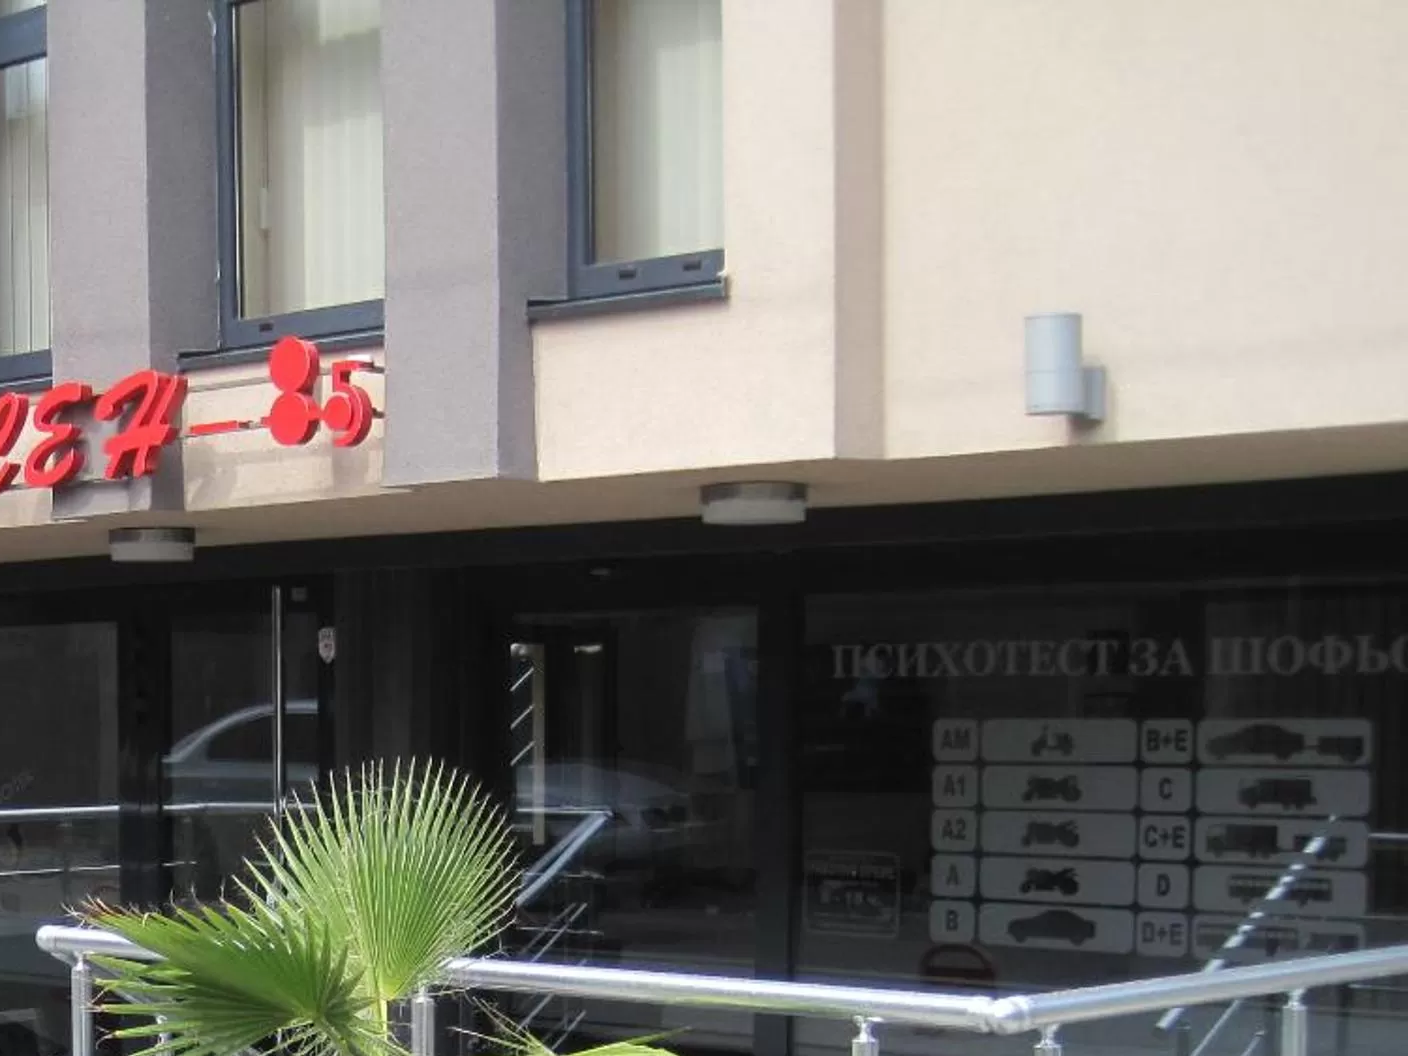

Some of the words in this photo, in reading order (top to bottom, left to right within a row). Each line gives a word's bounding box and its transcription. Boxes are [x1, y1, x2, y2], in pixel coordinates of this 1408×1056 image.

[831, 638, 1128, 679] ПСИХОТЕСТ
[1129, 636, 1192, 677] ЗА
[1146, 729, 1189, 752] B+E
[943, 774, 966, 797] A1
[1158, 777, 1173, 800] C
[942, 818, 967, 841] A2
[1144, 825, 1186, 849] C+E
[945, 865, 959, 887] A
[1157, 873, 1172, 897] D
[944, 910, 959, 932] B
[1142, 921, 1185, 946] D+E
